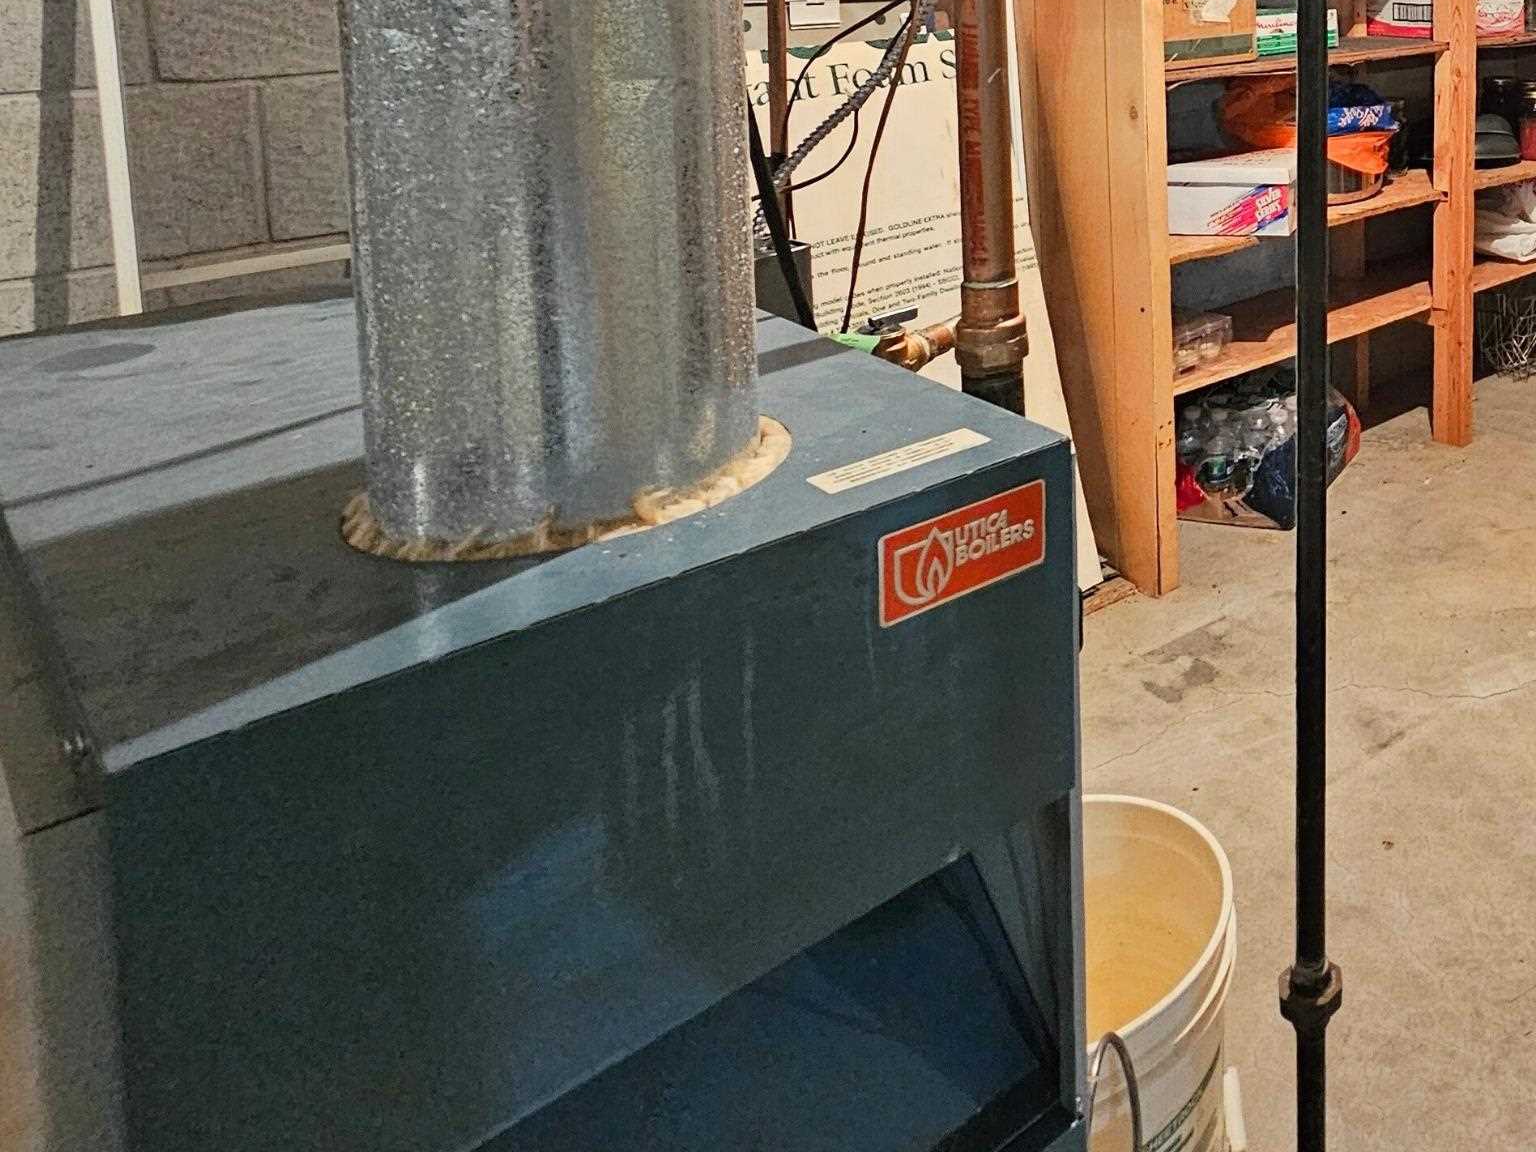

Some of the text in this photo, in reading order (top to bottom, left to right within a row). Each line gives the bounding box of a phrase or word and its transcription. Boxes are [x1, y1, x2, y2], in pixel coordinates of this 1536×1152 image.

[747, 70, 820, 106] ant
[826, 60, 931, 98] Fom
[952, 509, 1009, 545] UTICA
[954, 518, 1035, 568] BOILERS
